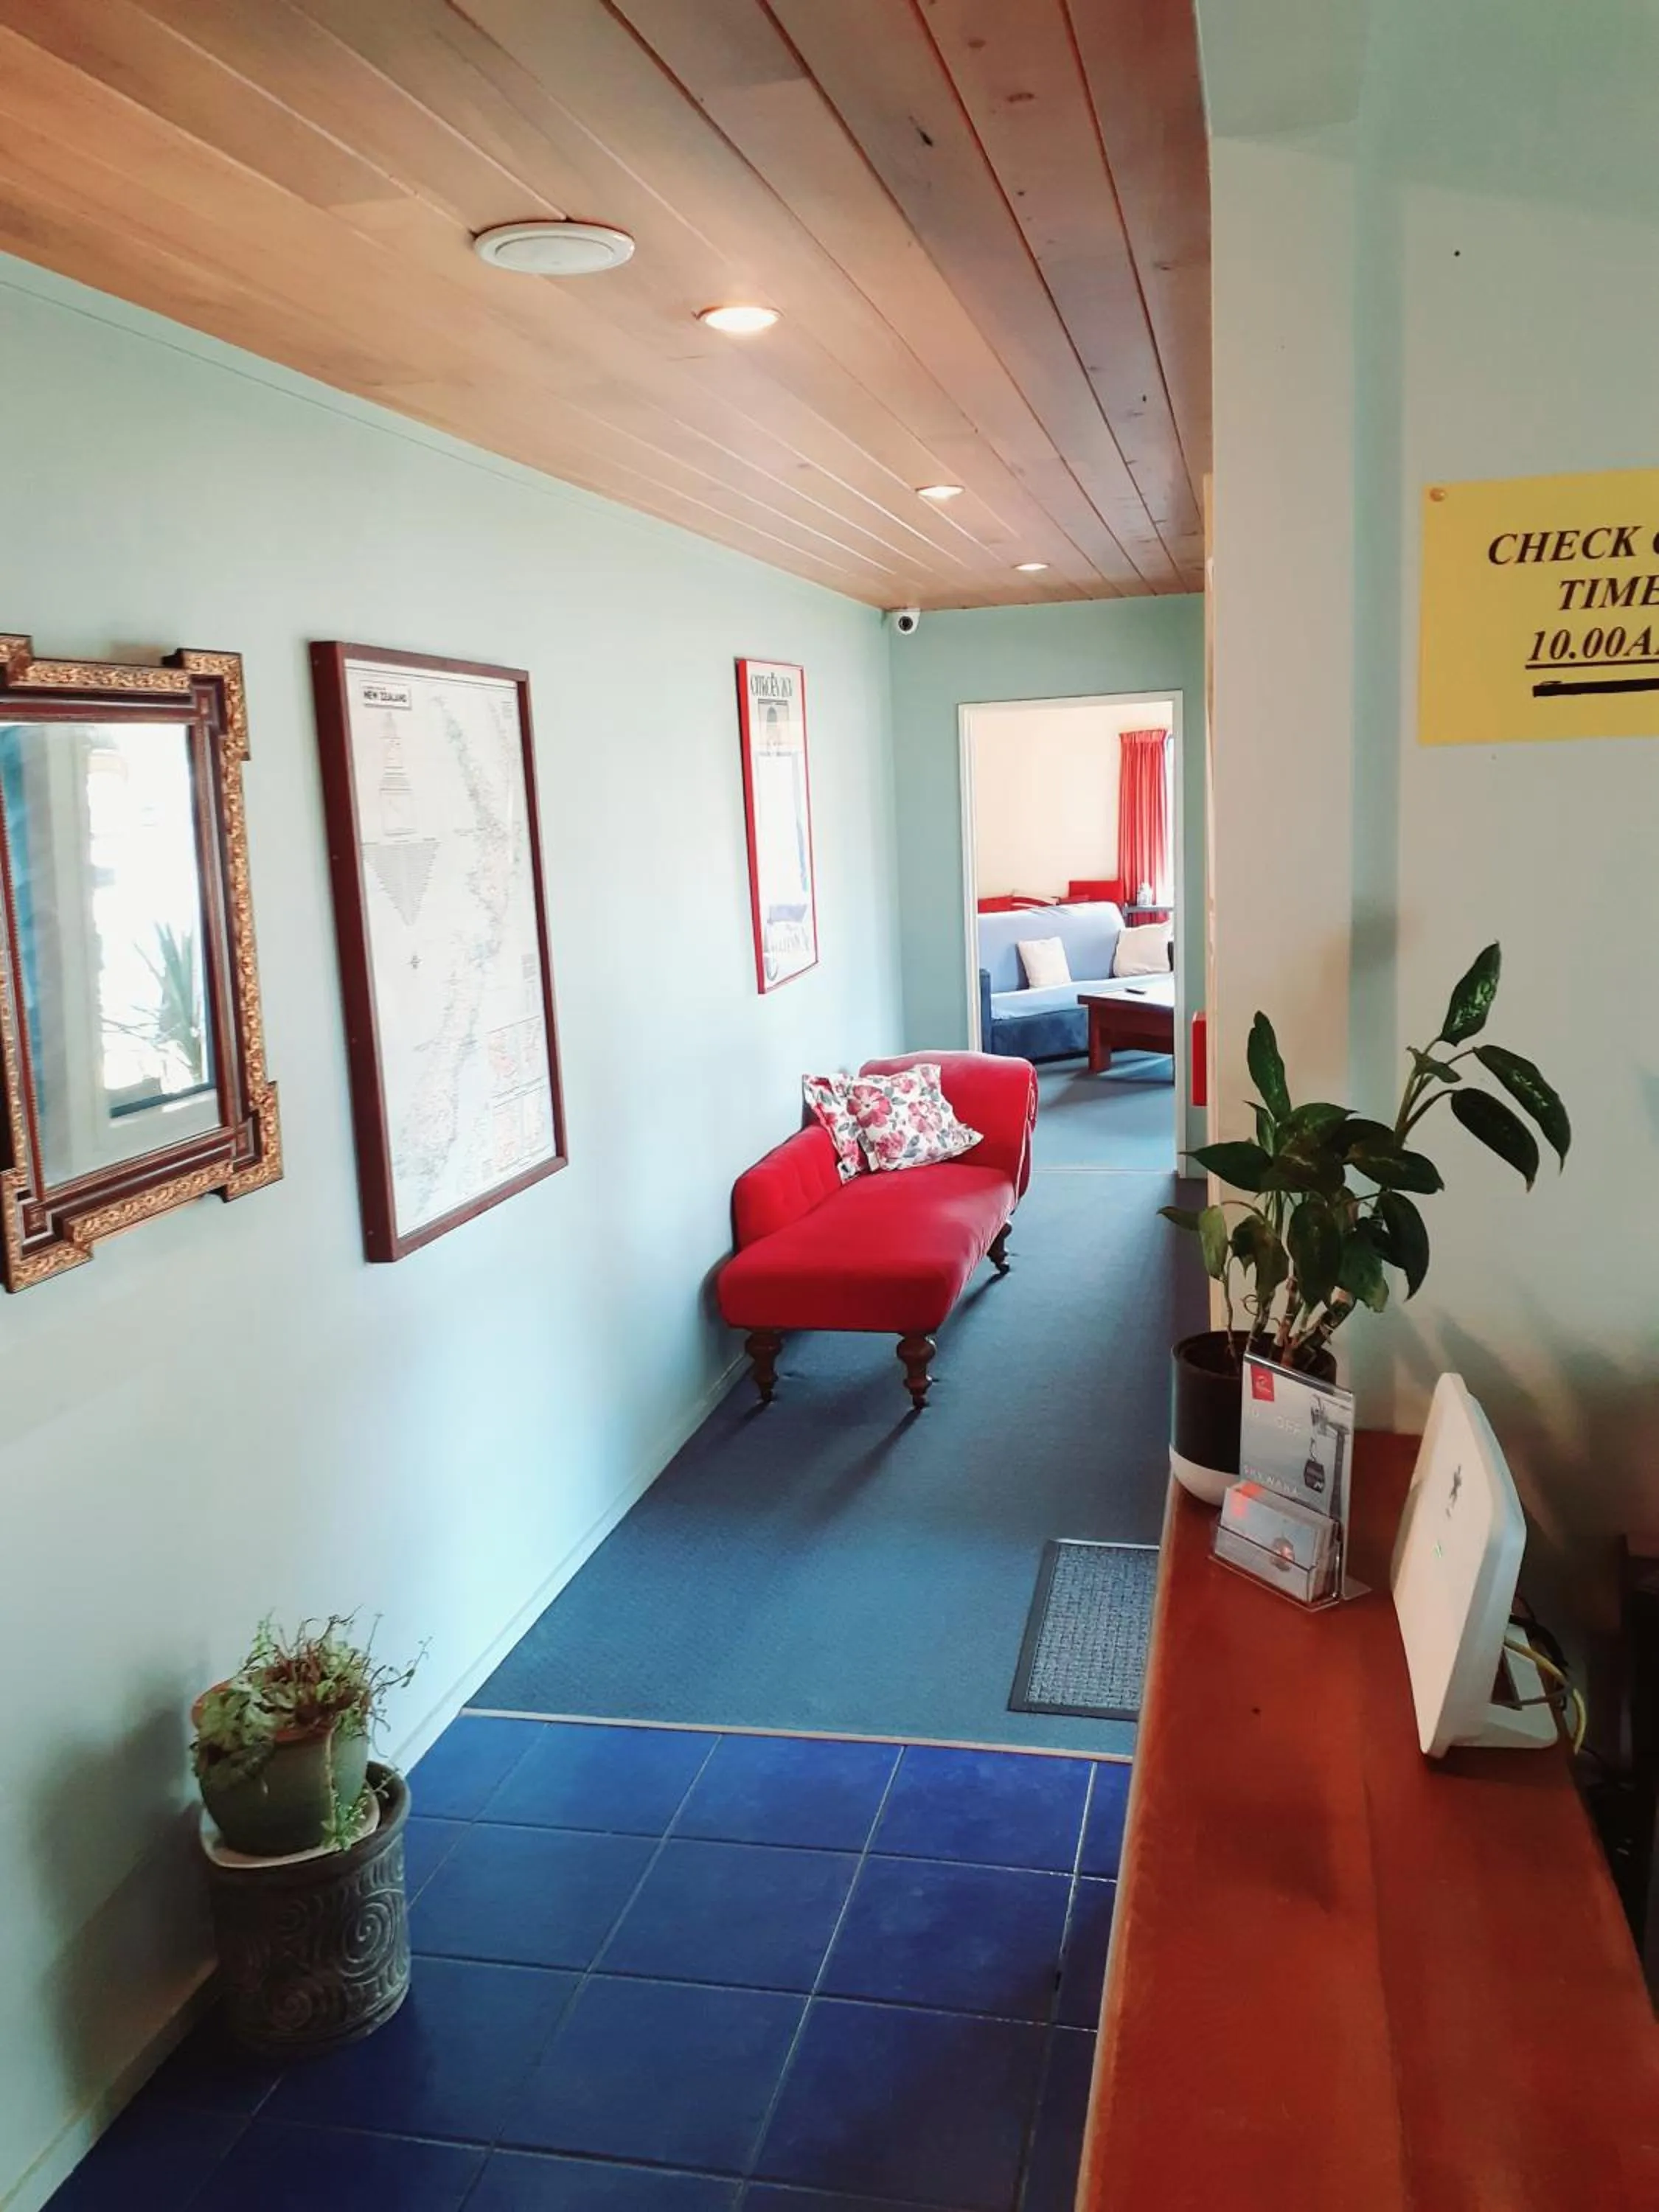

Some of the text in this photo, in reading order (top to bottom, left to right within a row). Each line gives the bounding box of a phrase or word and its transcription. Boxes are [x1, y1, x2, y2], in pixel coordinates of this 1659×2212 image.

[1488, 526, 1642, 565] CHECK
[1558, 574, 1659, 611] TIME
[1528, 625, 1659, 661] 10.00A
